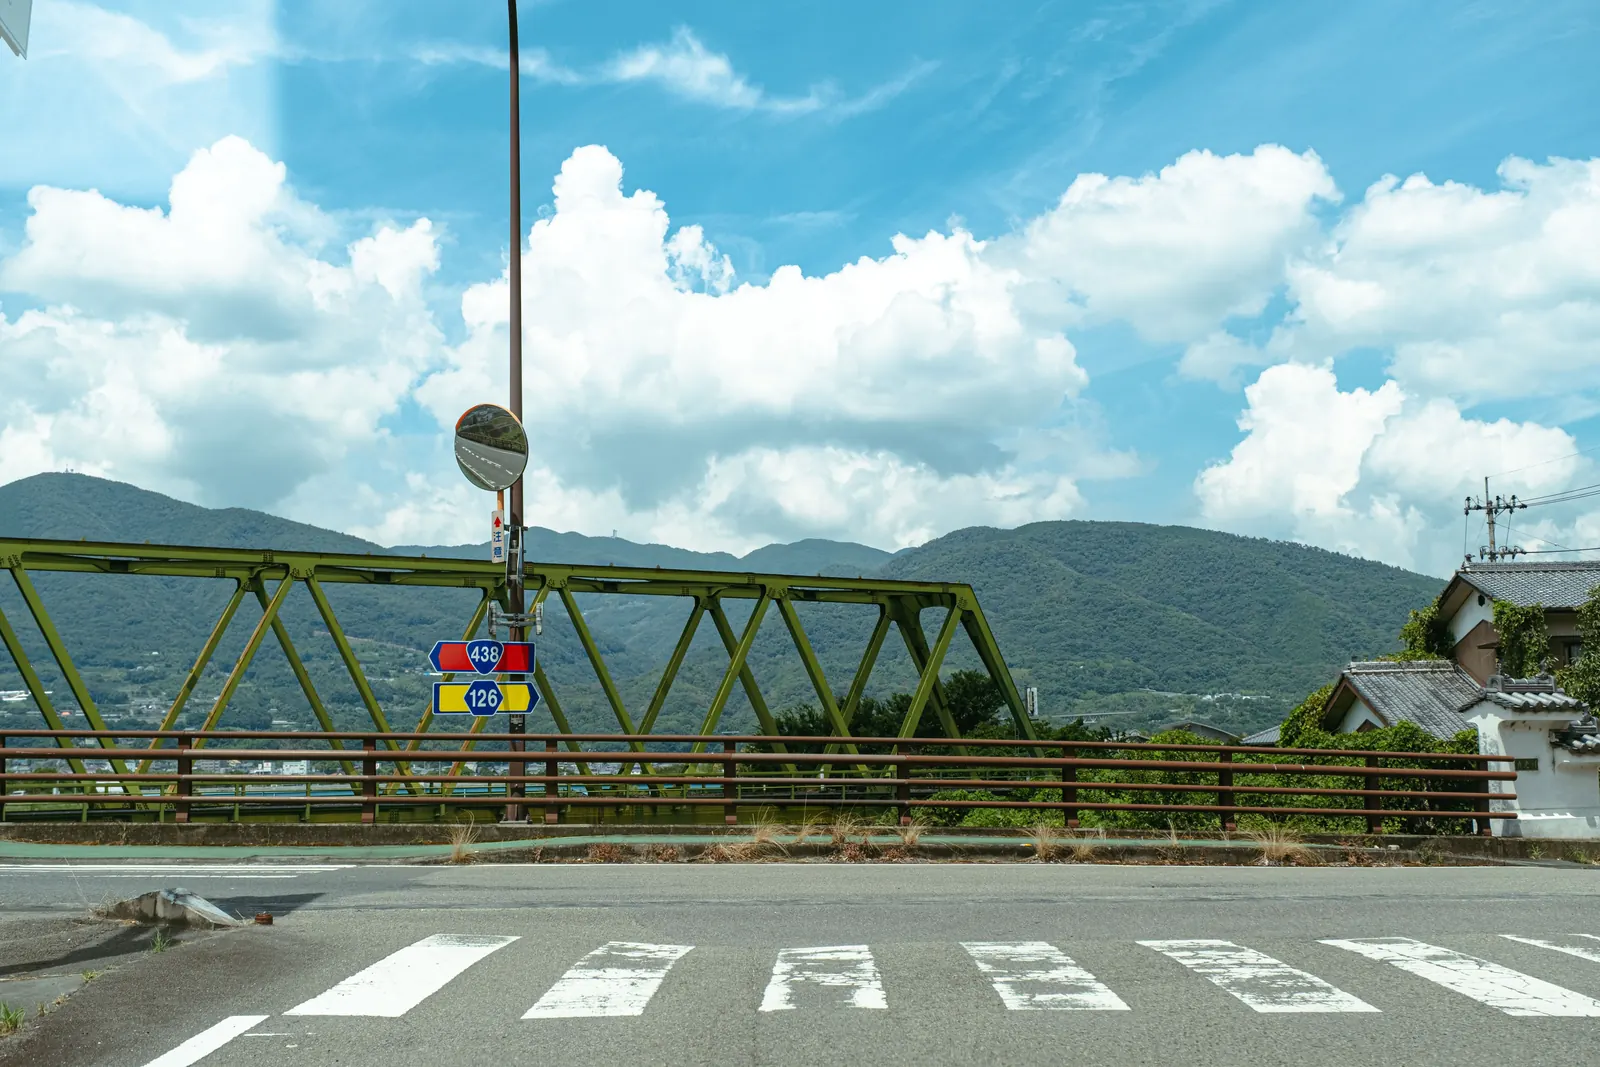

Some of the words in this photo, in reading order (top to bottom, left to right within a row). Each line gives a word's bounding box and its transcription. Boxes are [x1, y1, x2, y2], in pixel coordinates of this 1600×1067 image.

[493, 531, 502, 558] 注意
[471, 646, 499, 663] 438
[469, 689, 498, 707] 126
